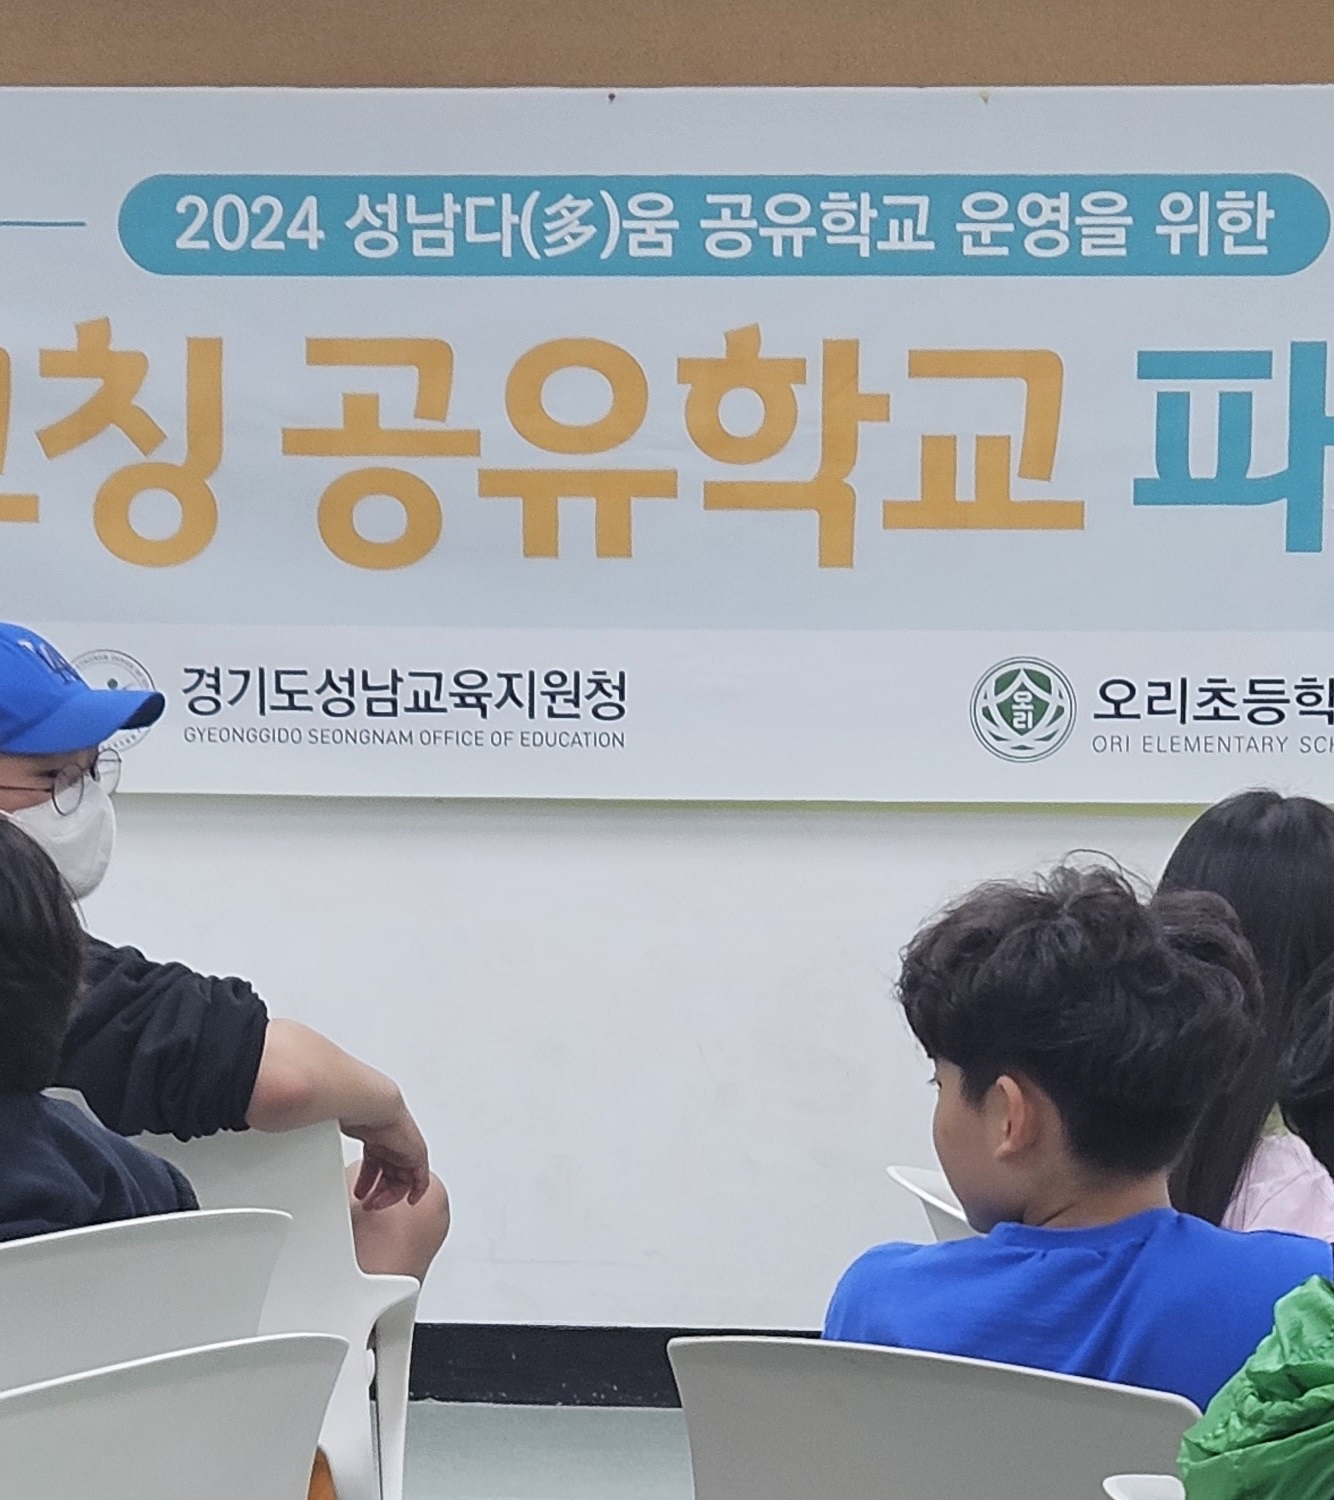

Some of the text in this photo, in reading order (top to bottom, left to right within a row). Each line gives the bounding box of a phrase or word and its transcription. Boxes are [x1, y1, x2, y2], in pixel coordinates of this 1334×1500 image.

[173, 190, 1277, 261] 2024 성남다(多)움 공유학교 운영을 위한
[281, 322, 1086, 571] 공유학교
[181, 666, 627, 721] 경기도성남교육지원청
[183, 726, 626, 749] GYEONGGIDO SEONGNAM OFFICE OF EDUCATION
[1092, 735, 1131, 754] ORI
[1142, 735, 1290, 754] ELEMENTARY
